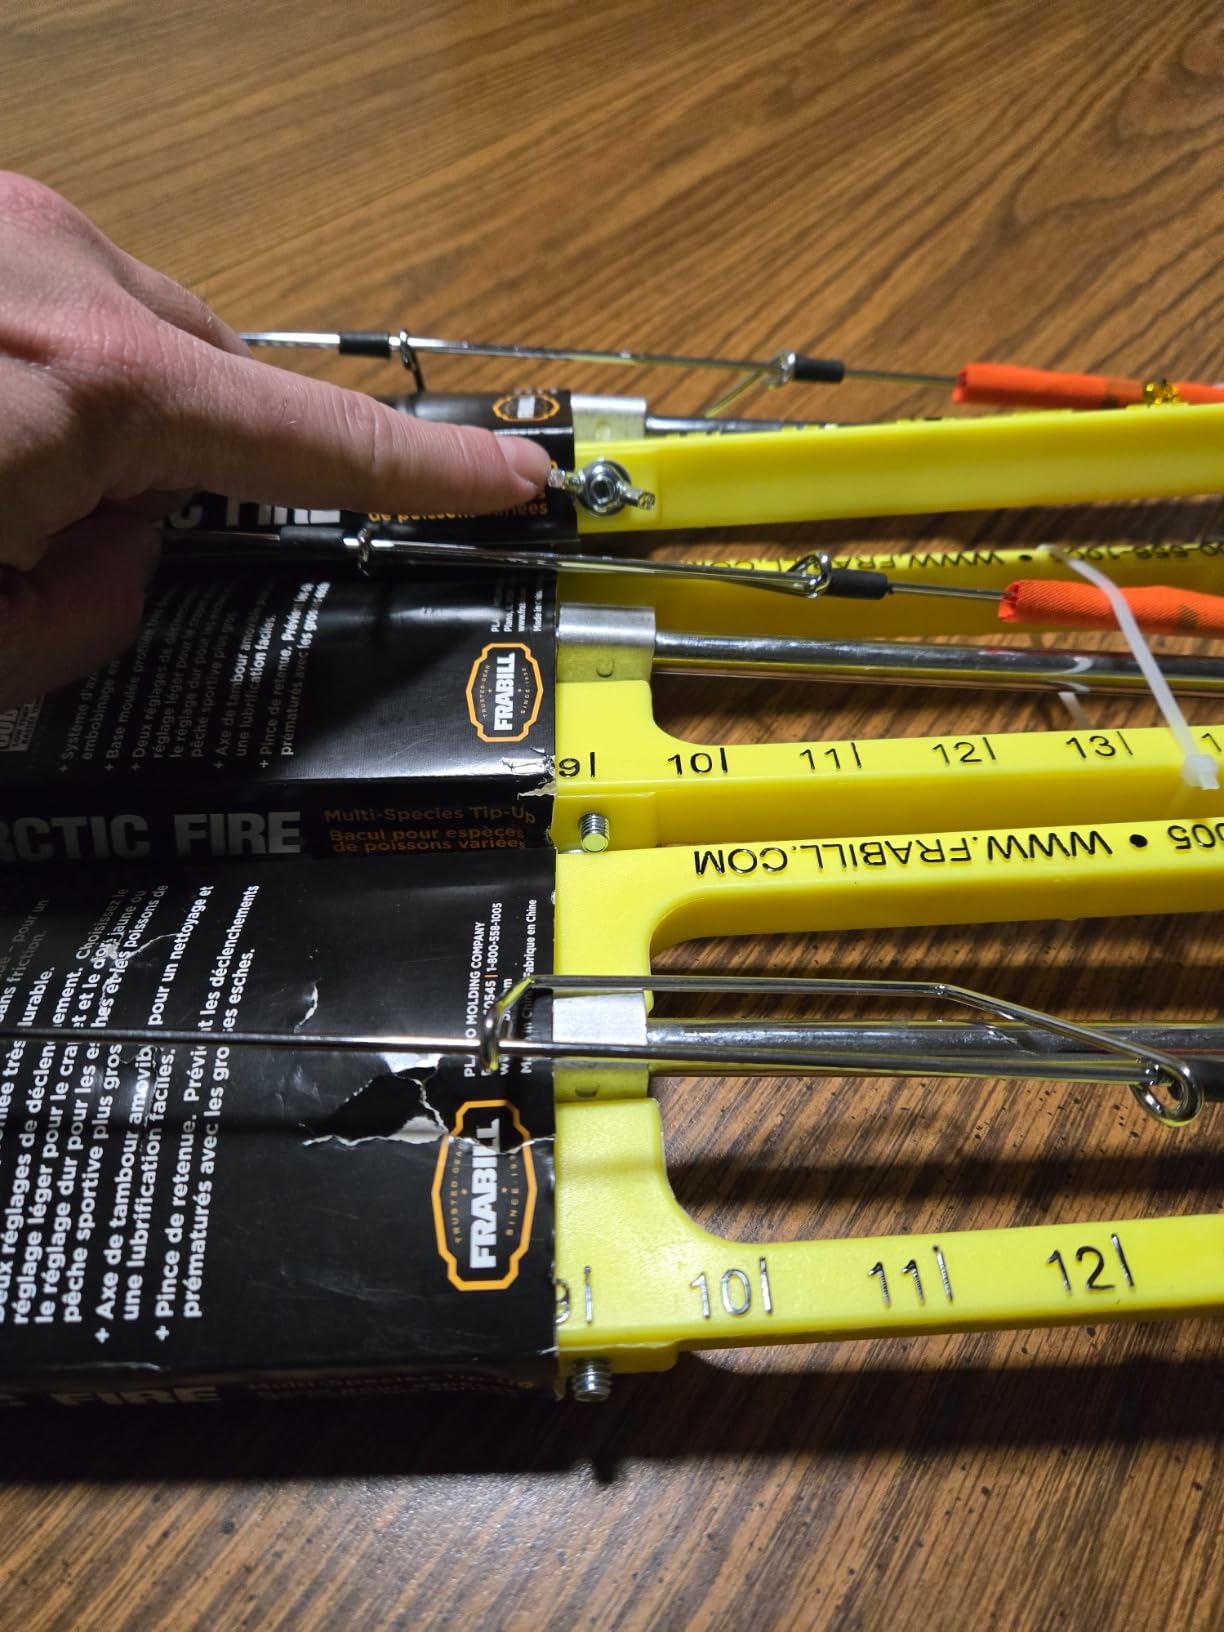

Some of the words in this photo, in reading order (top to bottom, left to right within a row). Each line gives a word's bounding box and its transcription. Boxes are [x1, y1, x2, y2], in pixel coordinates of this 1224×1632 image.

[494, 652, 515, 731] FRABILL
[173, 810, 303, 858] FIRE
[323, 808, 465, 823] Multi-Species
[471, 805, 536, 825] Tip-Up
[329, 828, 385, 842] Bacul
[391, 829, 440, 844] pour
[693, 829, 1113, 877] WWW.FRABILL.COM
[198, 884, 215, 898] et
[525, 899, 537, 923] Chine
[123, 898, 159, 948] poissons
[169, 898, 208, 960] nettoyage
[208, 884, 260, 988] déclenchements
[470, 921, 485, 970] COMPANY
[486, 902, 503, 973] 1-800-558-1005
[527, 924, 537, 936] en
[81, 973, 101, 989] le
[161, 963, 179, 983] un
[228, 948, 256, 1005] esches.
[466, 970, 481, 1026] MOLDING
[77, 992, 95, 1011] et
[147, 985, 171, 1026] pour
[200, 990, 221, 1015] les
[2, 1039, 26, 1077] très
[74, 1064, 97, 1094] les
[49, 1081, 70, 1101] le
[148, 1048, 177, 1121] faciles.
[203, 1086, 225, 1117] les
[42, 1105, 64, 1159] pour
[66, 1098, 89, 1151] pour
[200, 1123, 219, 1175] avec
[56, 1155, 79, 1197] dur
[61, 1246, 89, 1323] pêche
[75, 1145, 104, 1242] sportive
[91, 1095, 114, 1140] plus
[103, 1043, 123, 1090] gros
[108, 1130, 140, 1229] tambour
[171, 1113, 198, 1207] retenue.
[0, 1152, 32, 1255] réglages
[18, 1118, 38, 1149] de
[25, 1163, 54, 1225] léger
[126, 1127, 163, 1268] lubrification
[469, 1117, 499, 1269] FRABILL
[40, 1201, 72, 1295] réglage
[103, 1234, 125, 1266] de
[164, 1212, 185, 1244] de
[182, 1180, 213, 1318] prématurés
[10, 1230, 44, 1325] réglage
[95, 1271, 119, 1321] Axe
[123, 1274, 144, 1321] une
[155, 1249, 181, 1318] Pince
[33, 1299, 56, 1325] le
